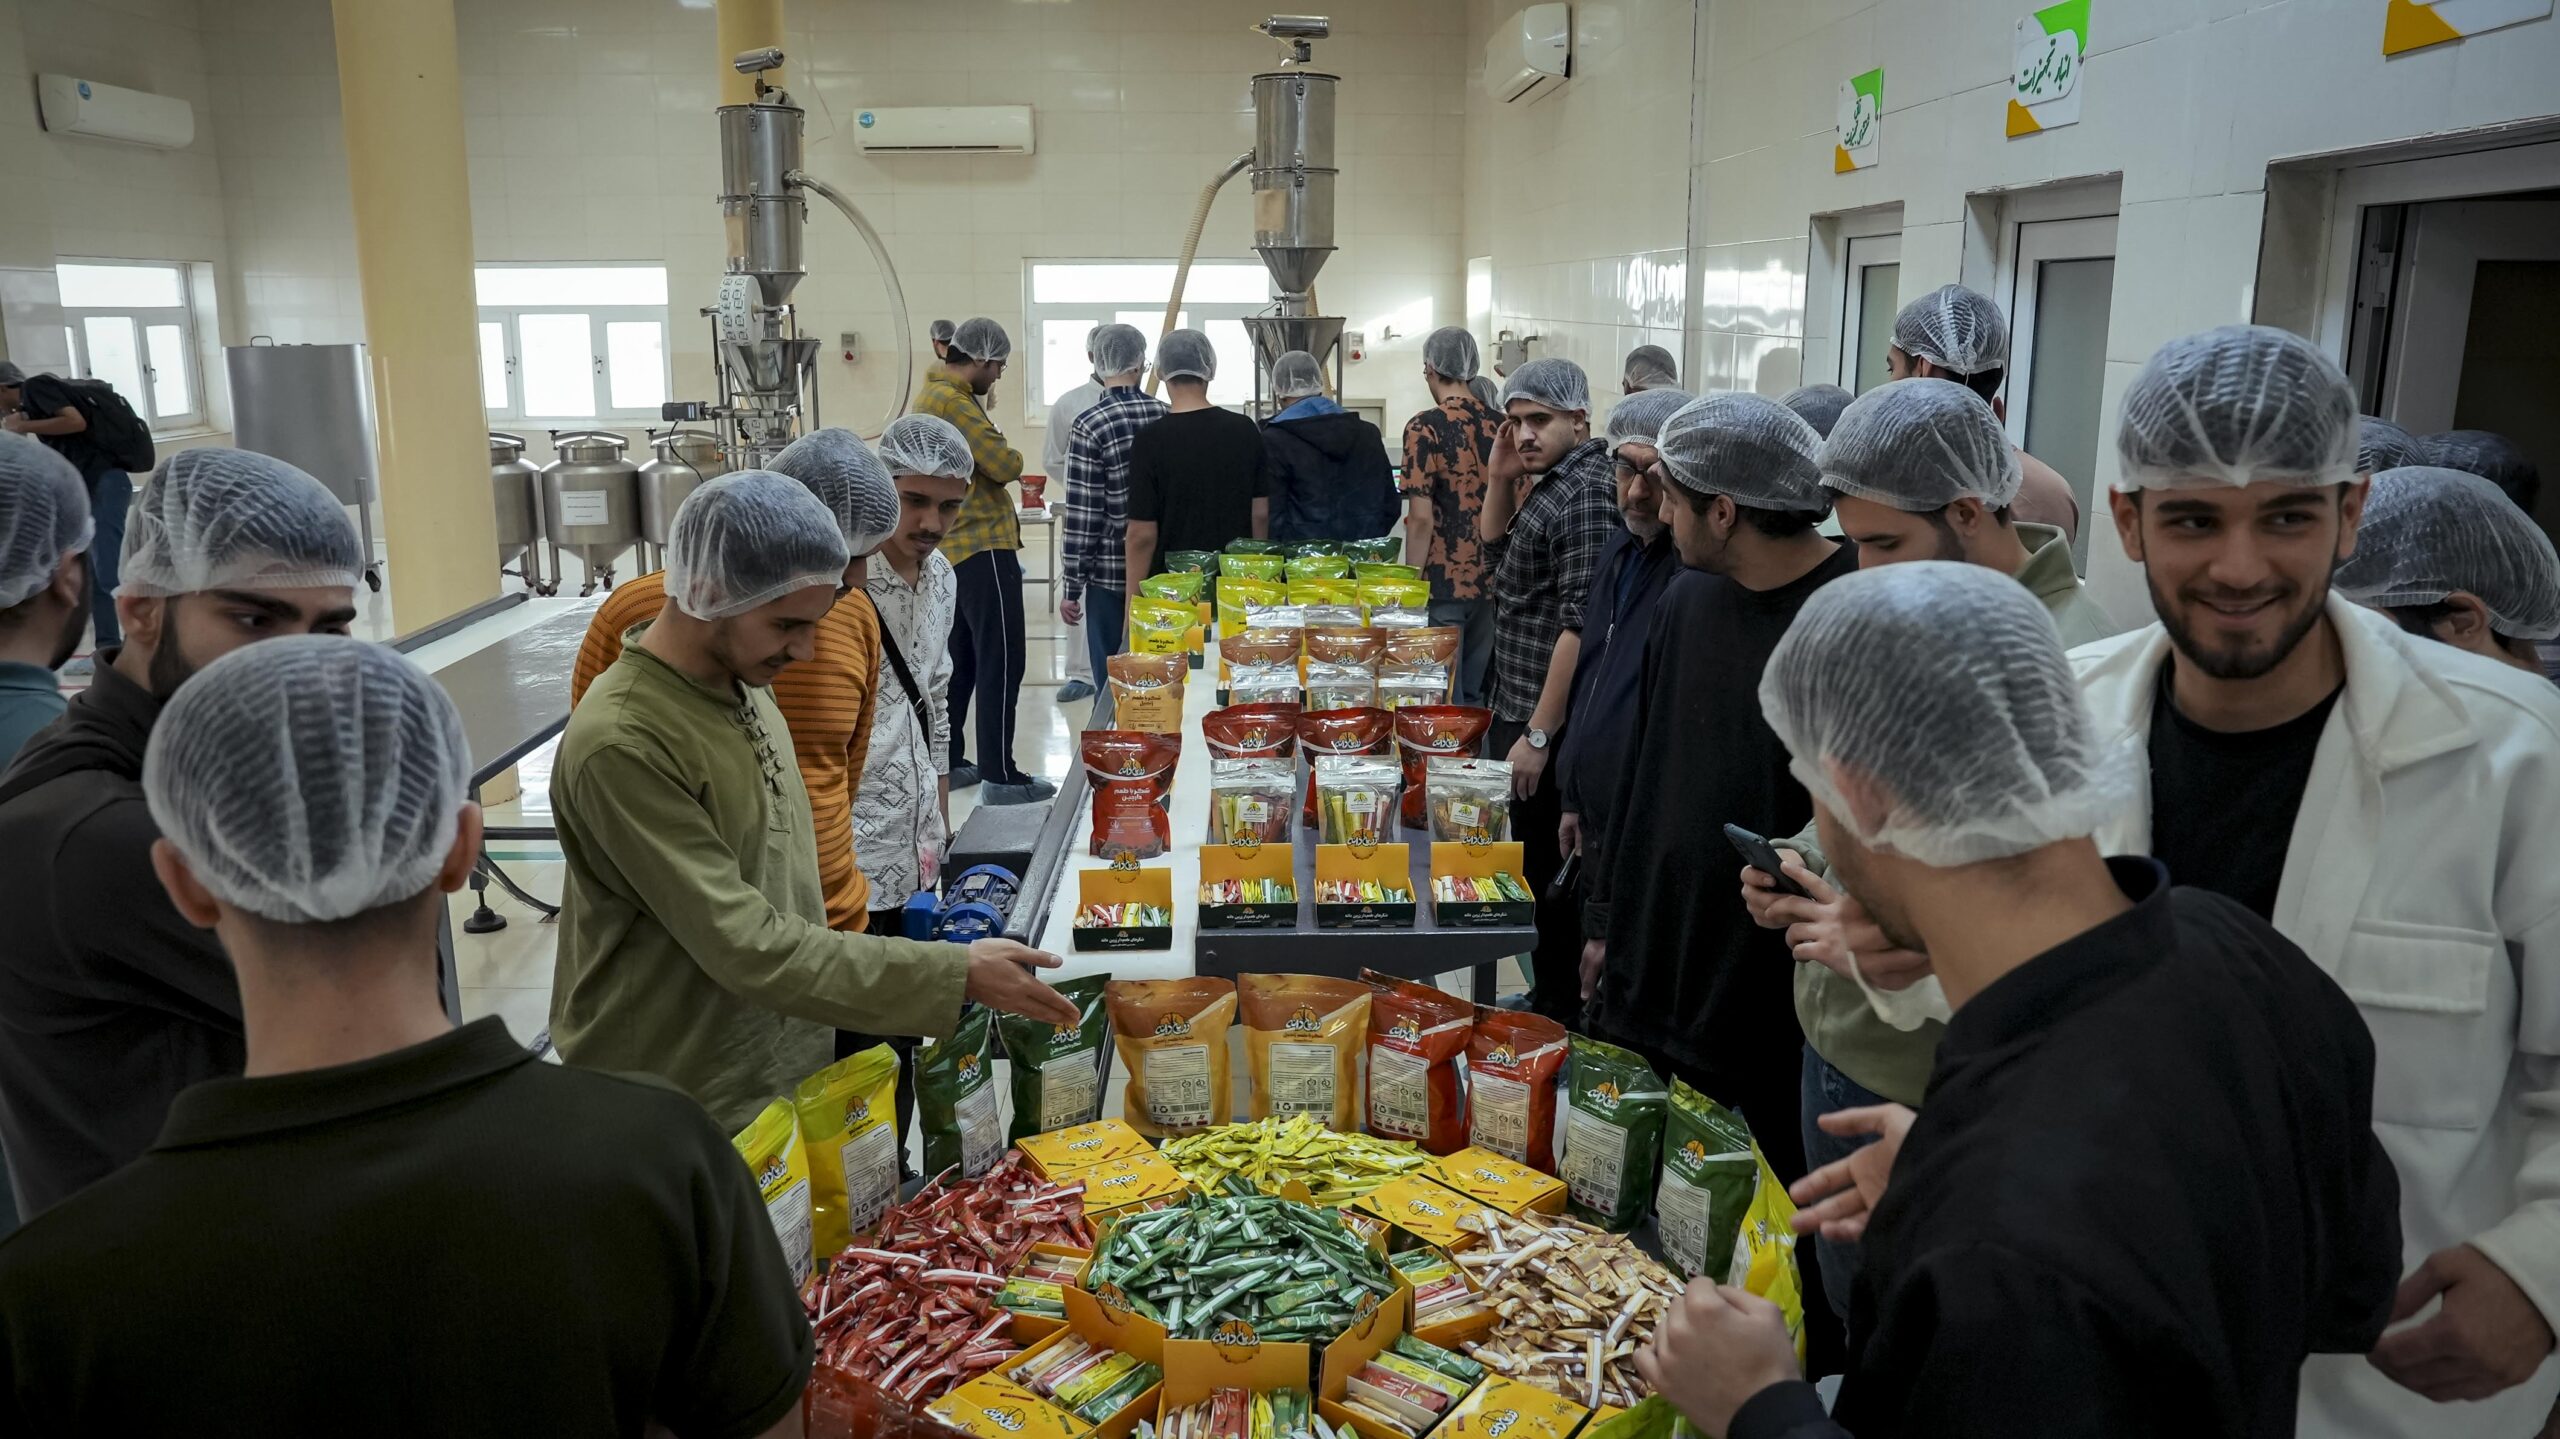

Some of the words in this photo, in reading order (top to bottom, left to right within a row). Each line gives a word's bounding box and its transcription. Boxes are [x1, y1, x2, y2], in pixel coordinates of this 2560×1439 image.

[2018, 38, 2056, 94] تجهیزات
[2054, 54, 2071, 91] انبار
[1132, 787, 1150, 795] شکر
[1155, 1024, 1173, 1036] دانه
[1172, 1022, 1190, 1035] زرین
[1285, 1018, 1304, 1031] دانه
[1303, 1018, 1322, 1032] زرین
[1211, 1330, 1237, 1346] دانه
[1236, 1331, 1261, 1347] زرین
